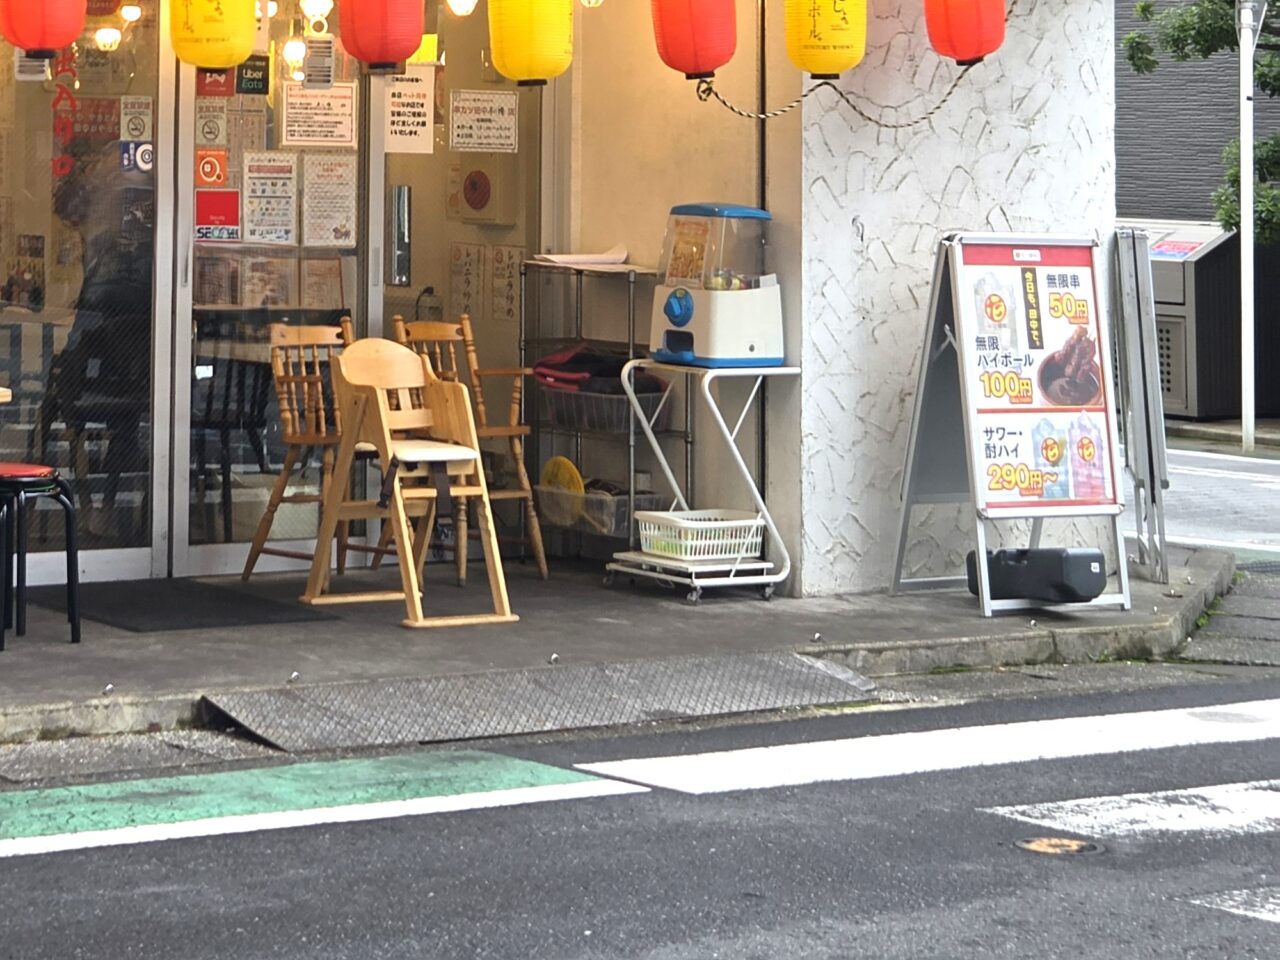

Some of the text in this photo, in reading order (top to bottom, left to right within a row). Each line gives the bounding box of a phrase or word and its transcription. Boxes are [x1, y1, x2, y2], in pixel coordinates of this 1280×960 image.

[242, 68, 263, 79] Uber
[241, 79, 263, 89] Eats
[1046, 274, 1081, 289] 無限串
[1048, 292, 1089, 319] 50円
[975, 336, 1000, 351] 無限
[977, 353, 1034, 368] ハイボール
[980, 371, 1033, 398] 100円
[984, 443, 1019, 459] 酎ハイ
